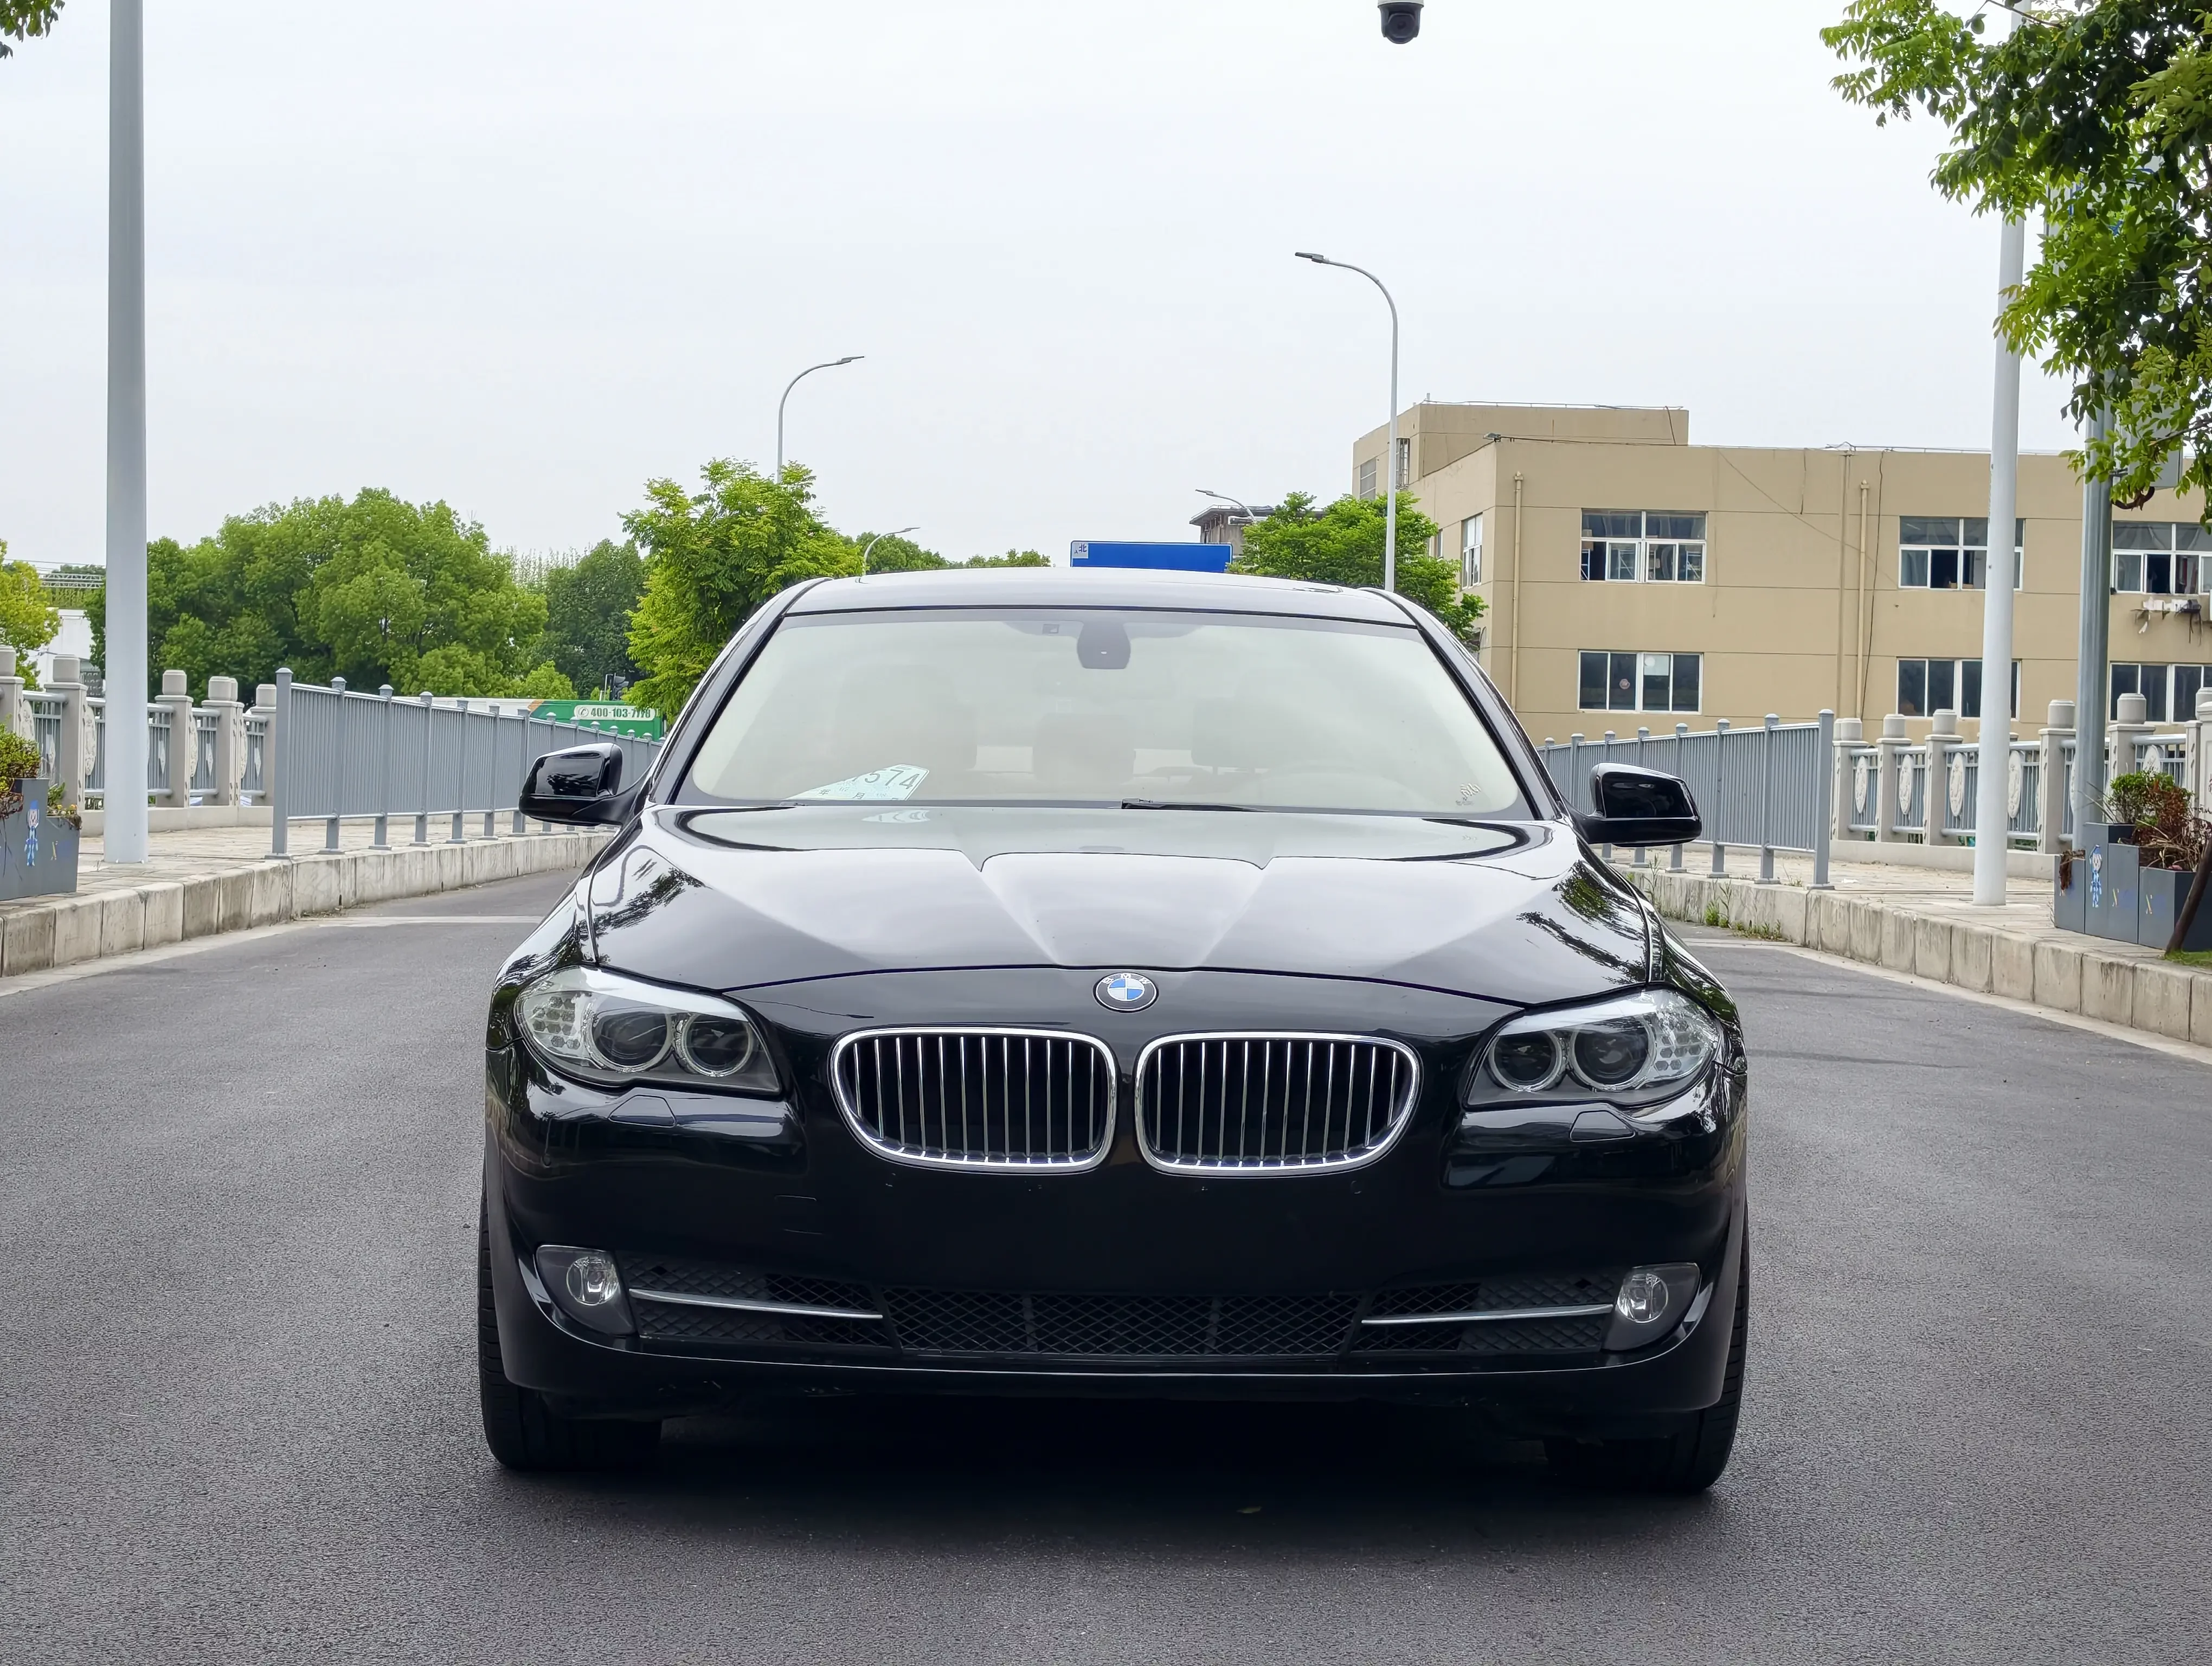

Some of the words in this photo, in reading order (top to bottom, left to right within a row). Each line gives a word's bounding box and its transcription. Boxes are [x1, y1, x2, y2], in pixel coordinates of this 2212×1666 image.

[1079, 544, 1087, 552] 北
[852, 769, 920, 790] 574
[1101, 972, 1152, 985] BMW
